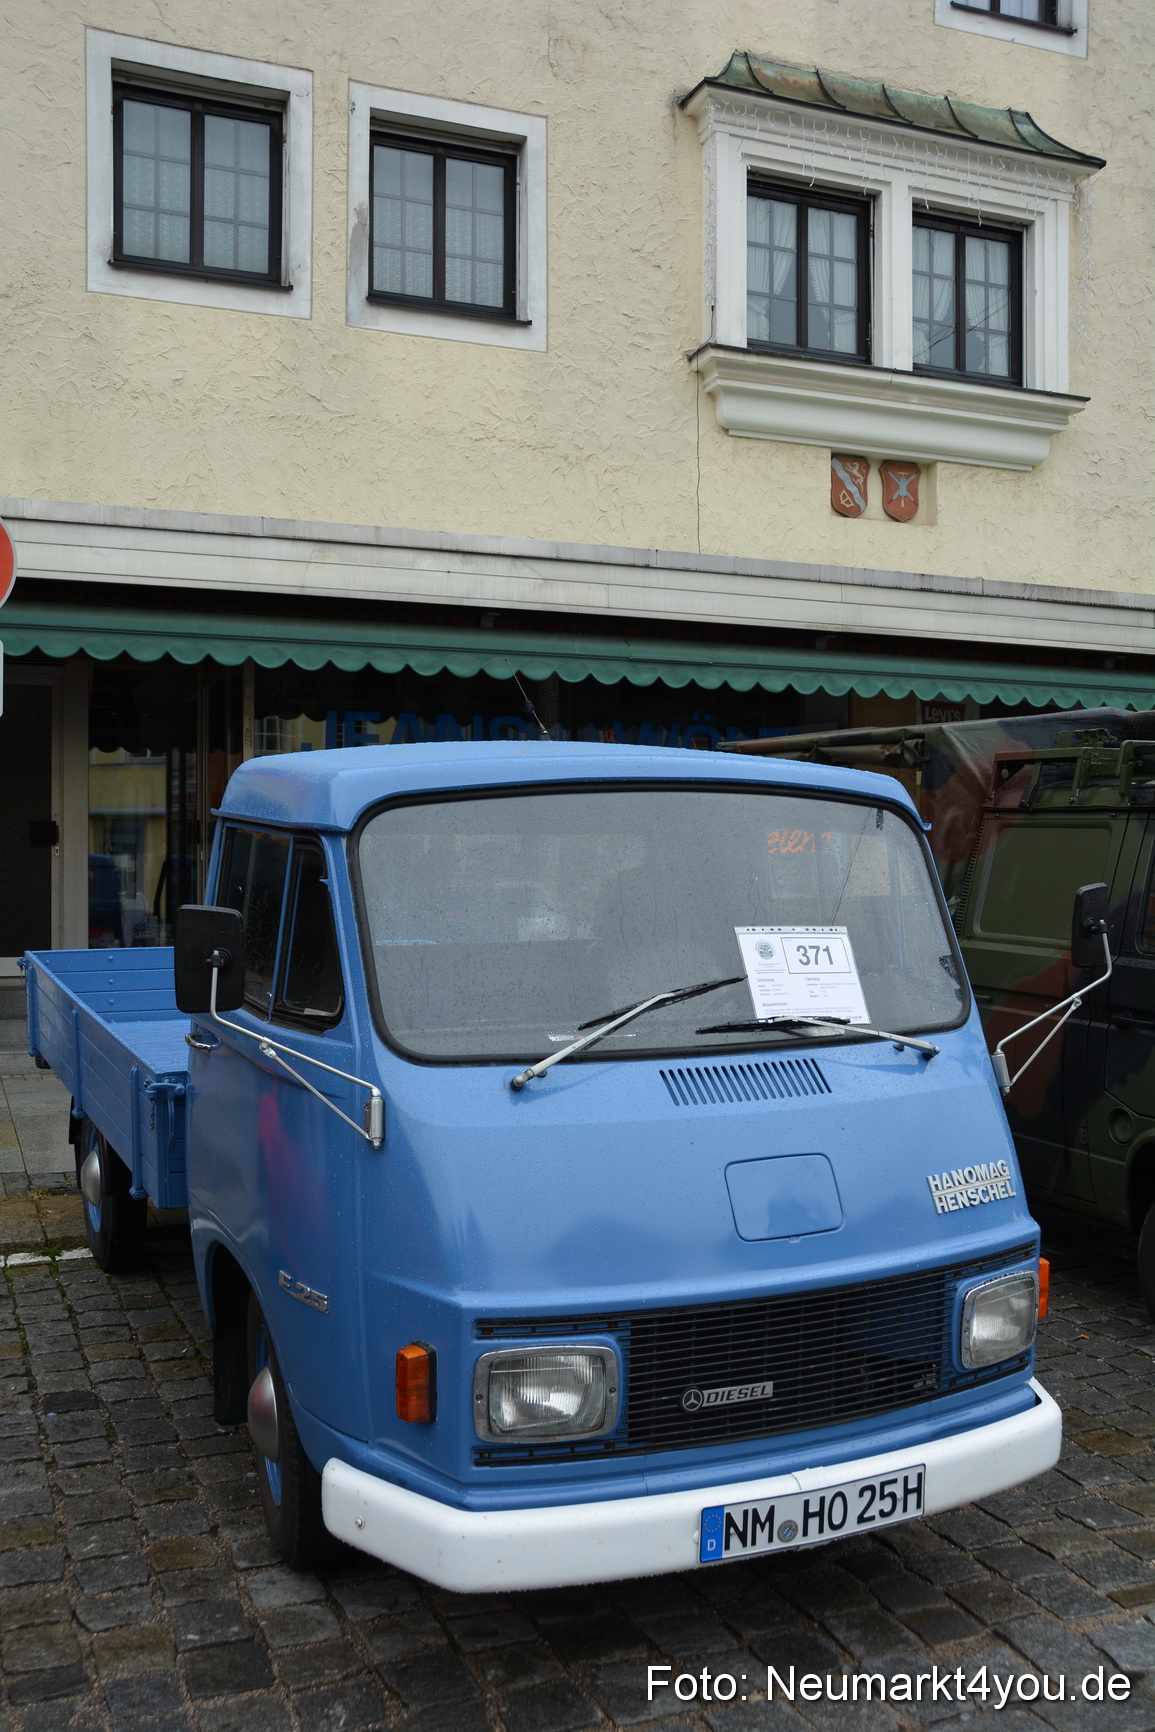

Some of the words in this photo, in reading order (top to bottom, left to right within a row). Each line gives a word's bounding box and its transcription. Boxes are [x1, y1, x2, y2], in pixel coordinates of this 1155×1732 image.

[796, 944, 834, 966] 371
[927, 1159, 1011, 1192] HANOMAG
[933, 1180, 1017, 1214] HENSCHEL
[705, 1384, 770, 1404] DIESEL
[724, 1504, 776, 1551] NM
[802, 1490, 848, 1538] HO
[856, 1471, 923, 1525] 25H
[707, 1538, 716, 1551] D
